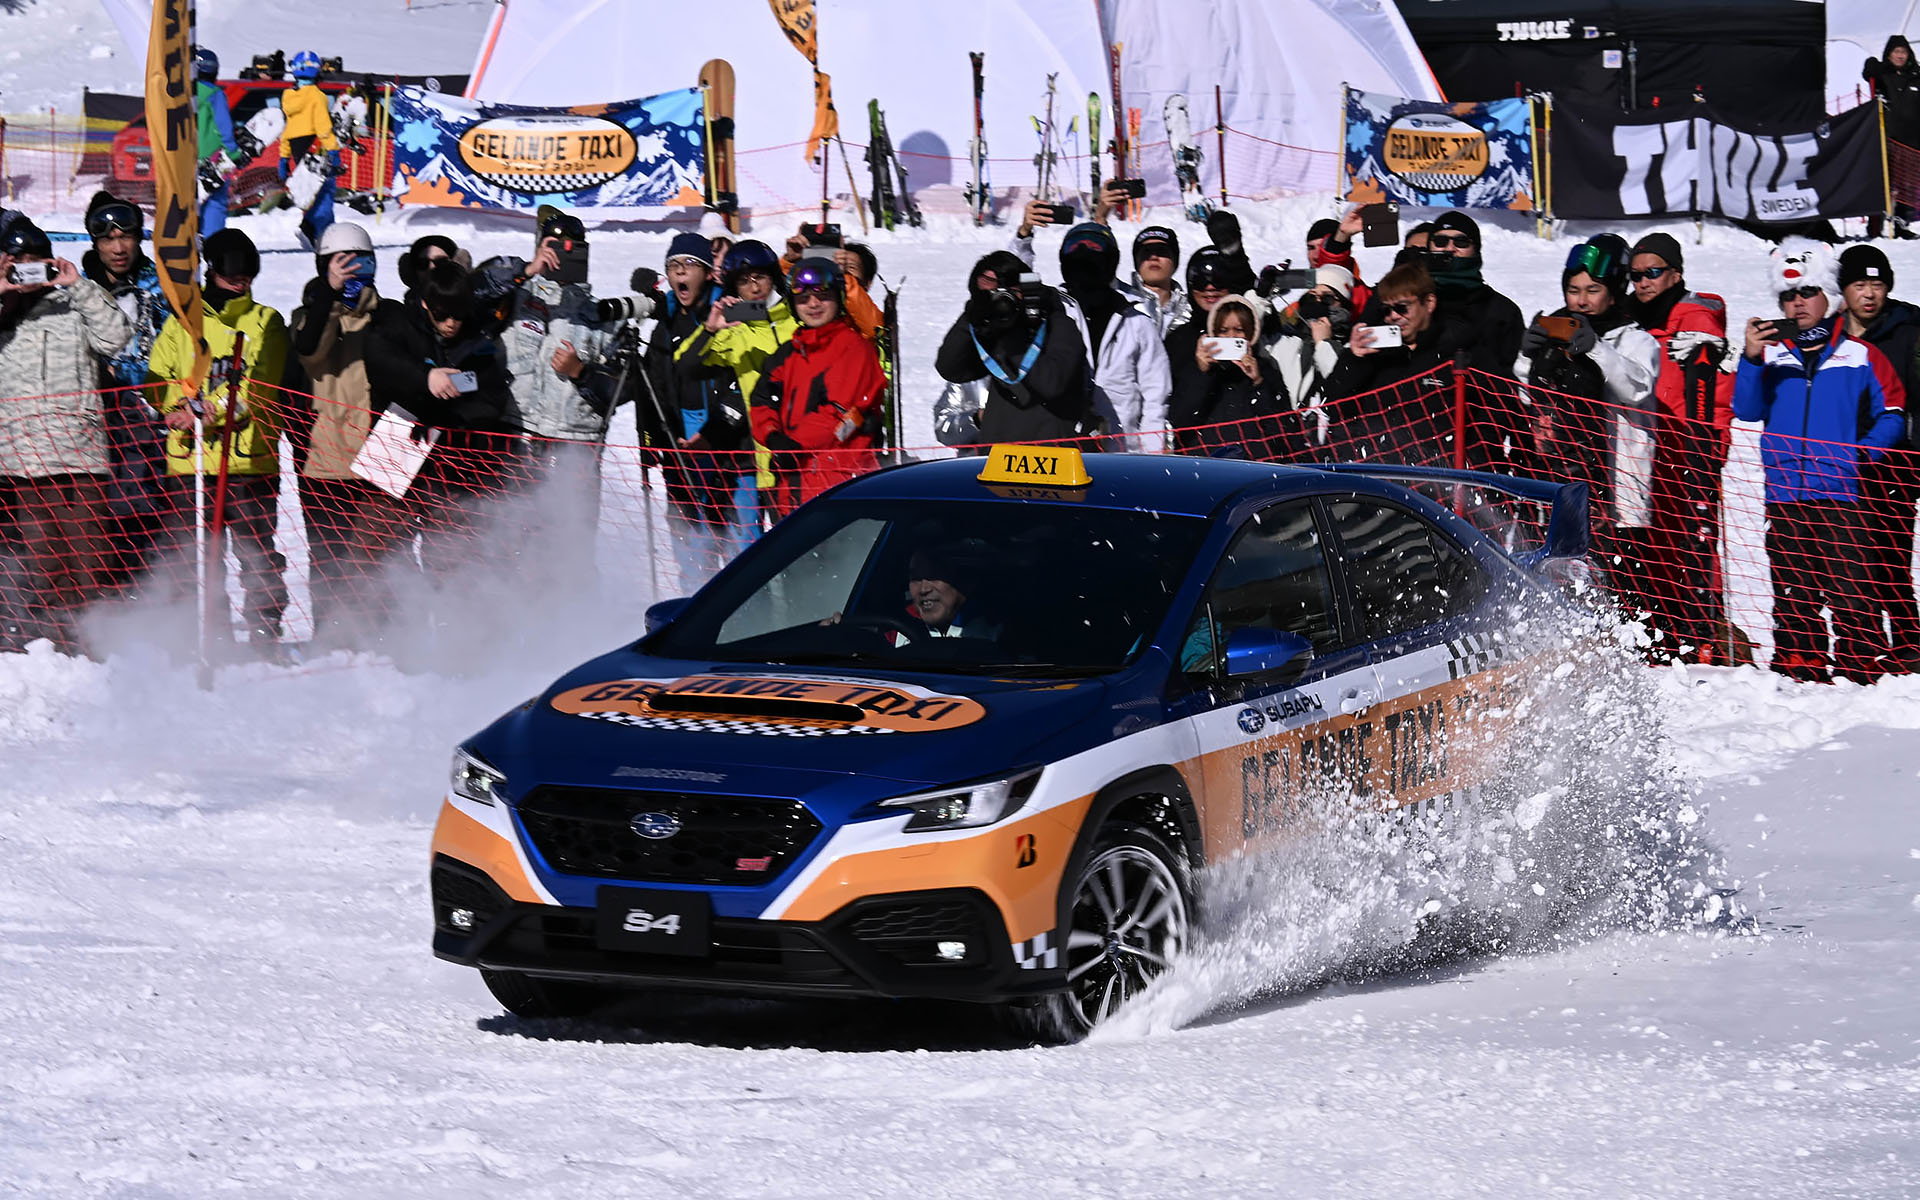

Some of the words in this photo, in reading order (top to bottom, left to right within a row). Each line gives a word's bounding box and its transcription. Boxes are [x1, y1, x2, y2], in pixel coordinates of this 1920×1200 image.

[1497, 20, 1572, 41] THULE
[473, 133, 568, 161] GELANDE
[578, 132, 623, 160] TAXI
[1613, 117, 1820, 220] THULE
[1761, 196, 1810, 213] SWEDEN
[1004, 454, 1058, 475] TAXI
[836, 687, 963, 721] TAXI
[1266, 694, 1322, 722] SUBARU
[1385, 700, 1446, 794] TAXI
[623, 908, 681, 935] S4
